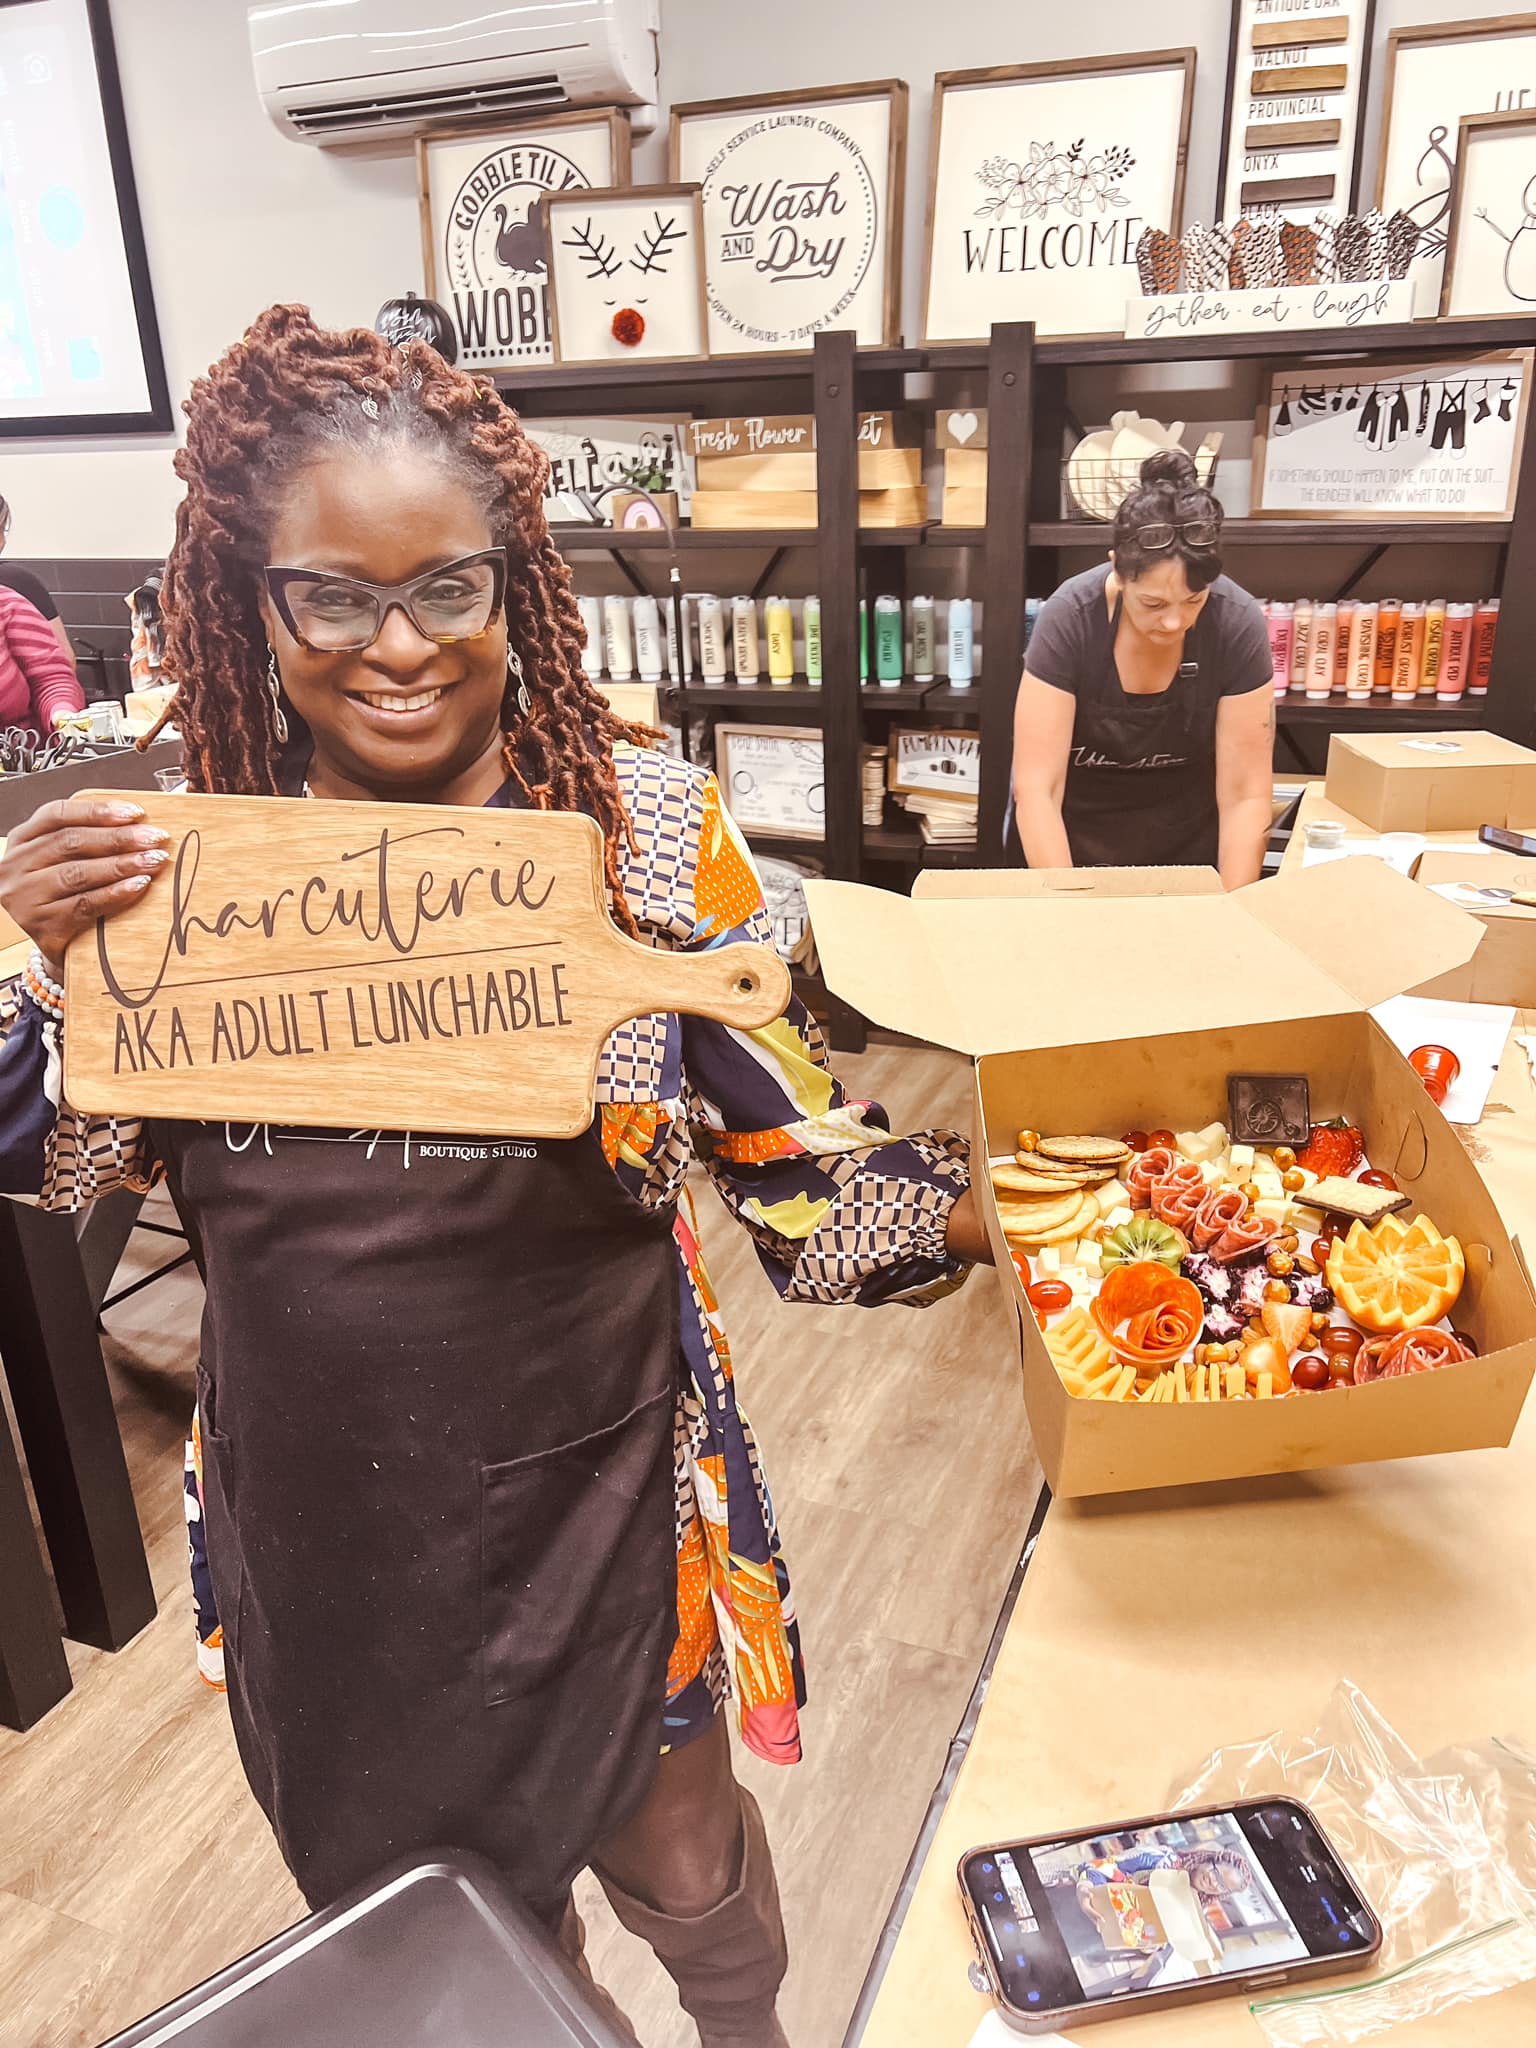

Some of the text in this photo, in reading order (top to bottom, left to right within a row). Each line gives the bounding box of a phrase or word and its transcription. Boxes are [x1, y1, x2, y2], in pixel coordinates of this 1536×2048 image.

[1253, 48, 1308, 67] WALNUT
[1248, 97, 1327, 119] PROVINCIAL
[705, 115, 862, 174] SELF SERVICE LAUNDRY COMPANY
[1243, 154, 1280, 172] ONYX
[455, 152, 522, 231] GOBBLE
[529, 152, 557, 185] TIL
[721, 172, 847, 227] Wash
[722, 225, 847, 283] AND Dry
[963, 217, 1143, 273] WELCOME
[711, 300, 732, 324] OPEN
[830, 289, 856, 316] WEEK
[1144, 295, 1230, 337] gather
[1251, 293, 1290, 321] eat
[1312, 283, 1390, 326] laugh
[690, 419, 740, 454] Fresh
[744, 417, 807, 452] Flower
[1439, 469, 1454, 483] ON
[1456, 468, 1473, 482] THE
[1294, 646, 1306, 669] CORAL
[1314, 630, 1329, 677] CORAL CLAY
[1355, 618, 1373, 687] RAVISHING CORAL
[1396, 621, 1415, 687] ROBUST ORANGE
[1423, 620, 1442, 677] OSAGE ORANGE
[1447, 630, 1463, 681] ANTIQUE RED
[97, 827, 556, 1009] Charcuterie
[114, 963, 573, 1075] AKA ADULT LUNCHABLE
[419, 1145, 488, 1161] BOUTIQUE
